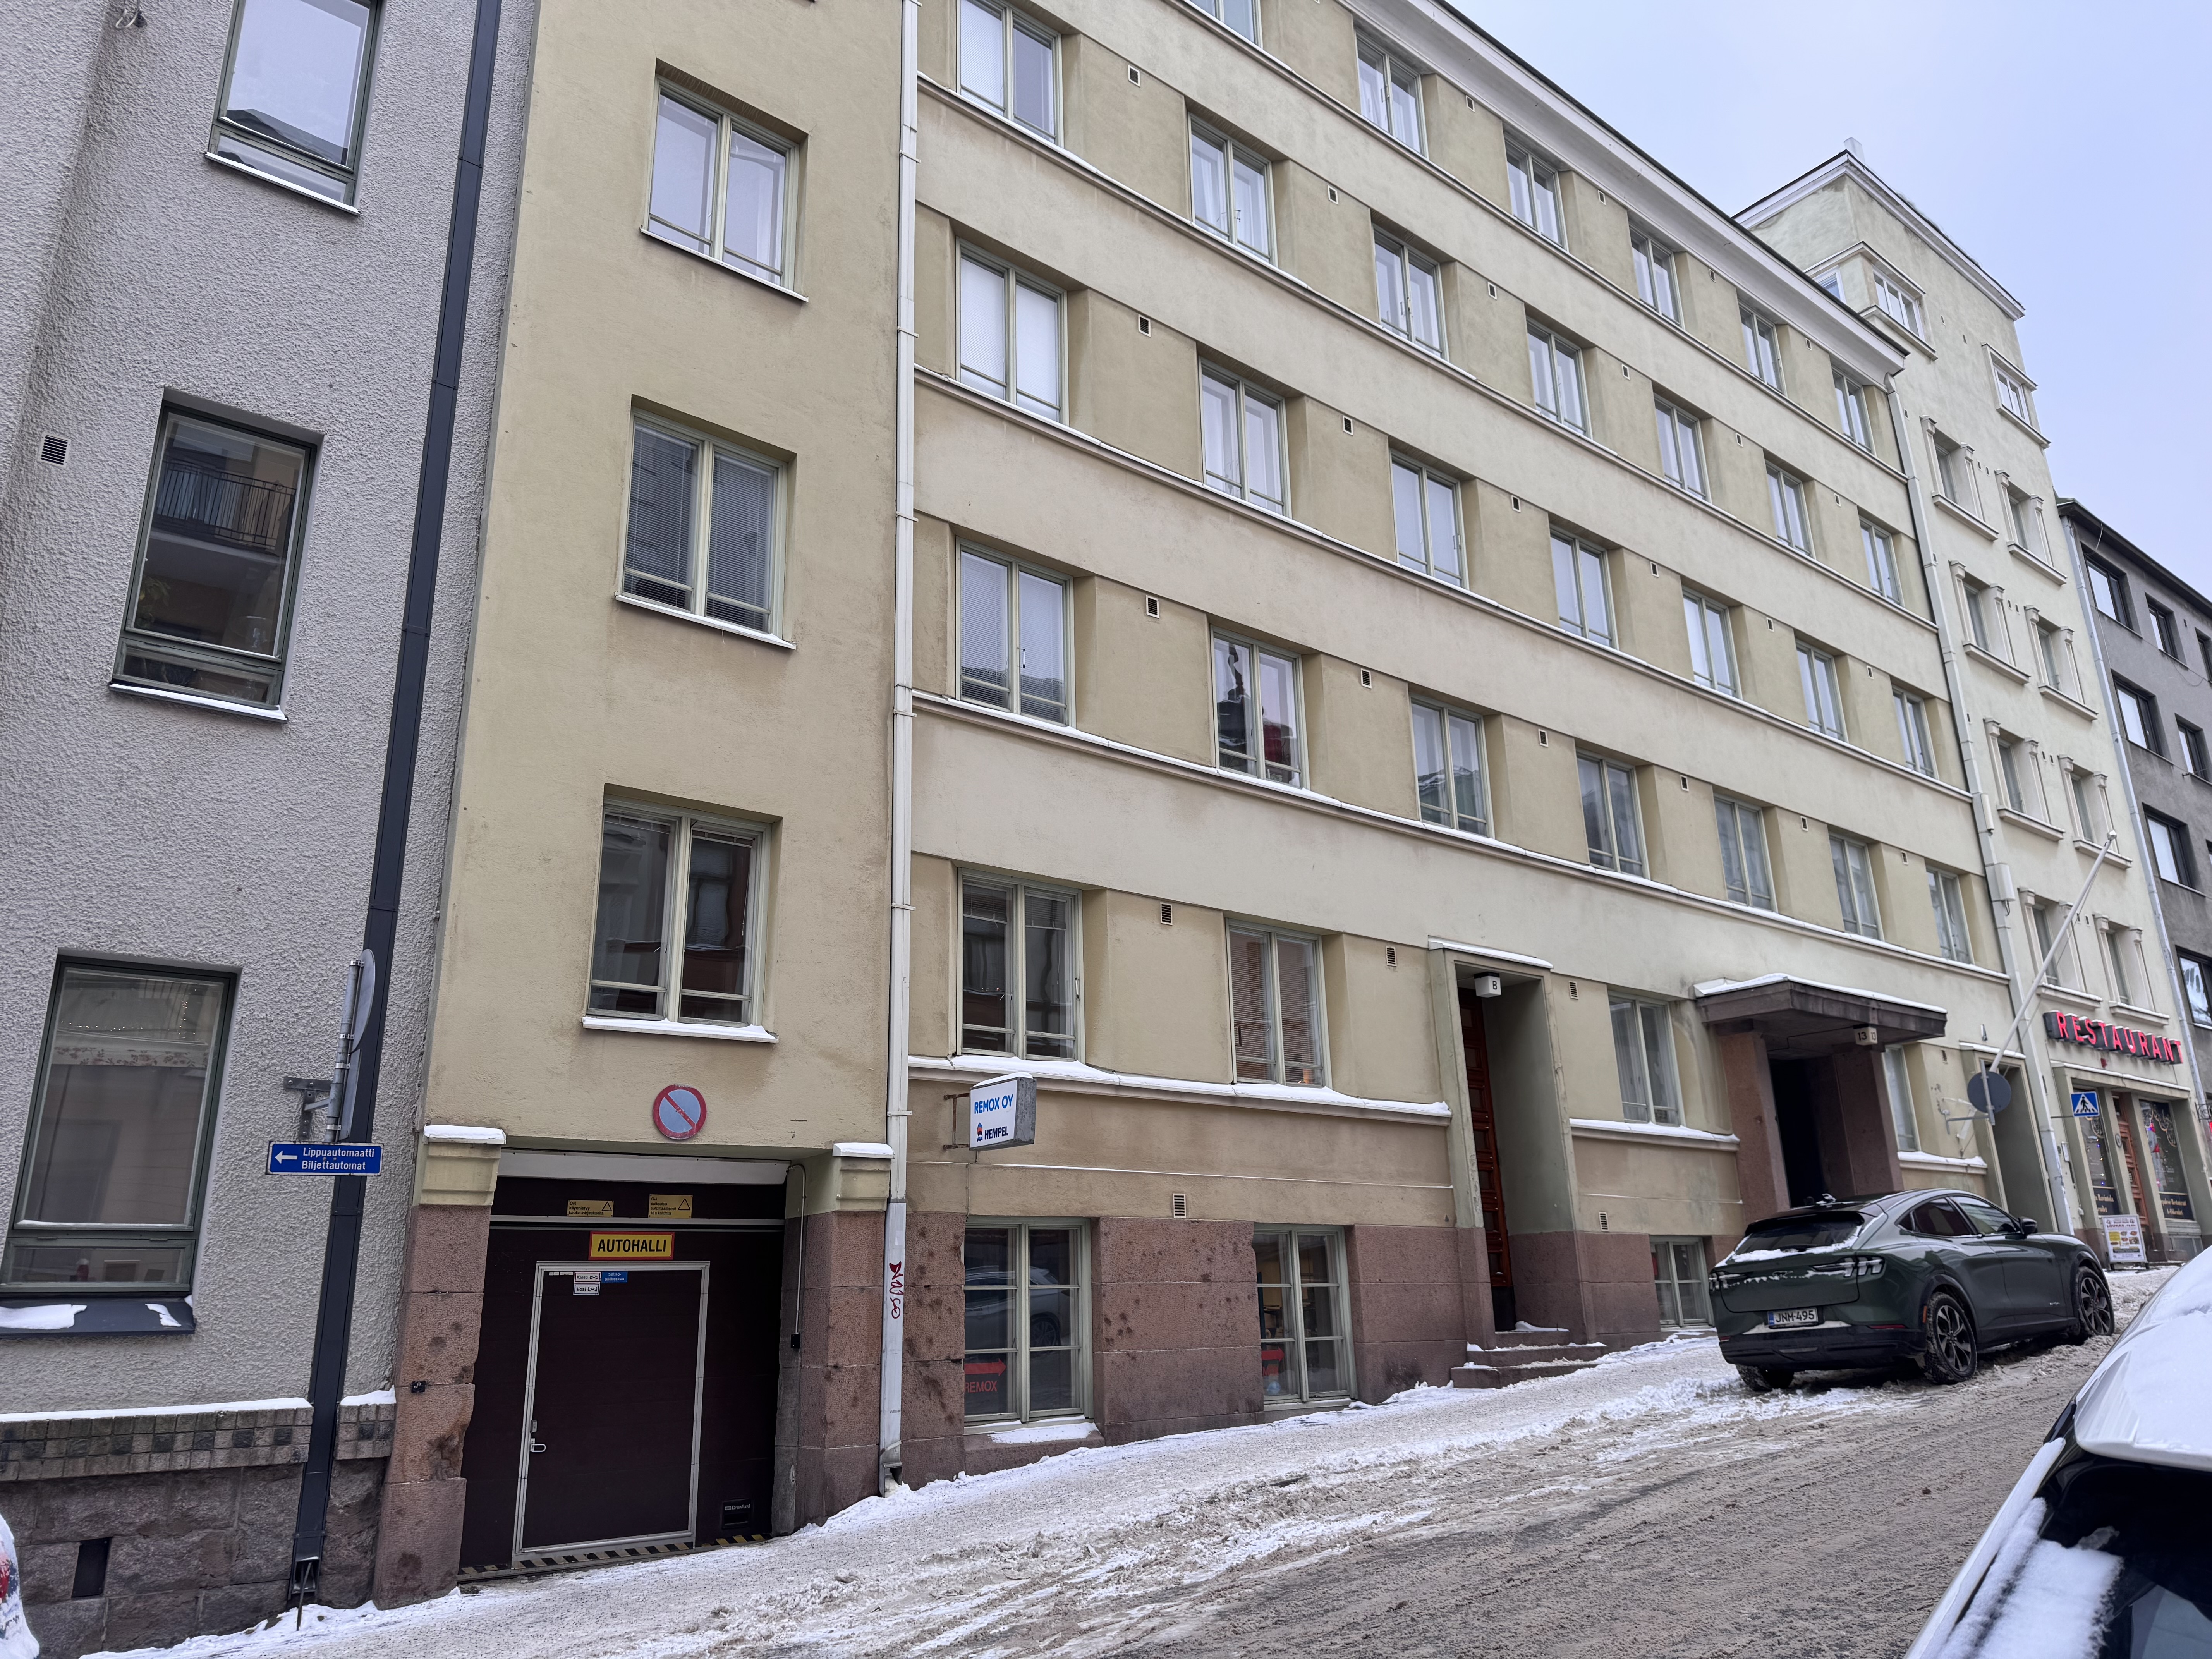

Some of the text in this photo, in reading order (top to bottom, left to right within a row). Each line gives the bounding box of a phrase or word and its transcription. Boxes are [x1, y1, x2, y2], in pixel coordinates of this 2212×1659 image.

[1492, 980, 1498, 990] B
[1858, 1032, 1867, 1041] 13
[1871, 1032, 1876, 1041] 13
[2056, 1012, 2183, 1064] RESTAURANT
[974, 1094, 1013, 1114] REMOX OY
[984, 1126, 1008, 1140] HEMPEL
[303, 1147, 375, 1158] Lippuautomaatti
[301, 1160, 366, 1171] Biljettautomat
[597, 1239, 666, 1252] AUTOHALLI
[1776, 1310, 1815, 1322] JNM-495
[965, 1380, 997, 1393] REMOX
